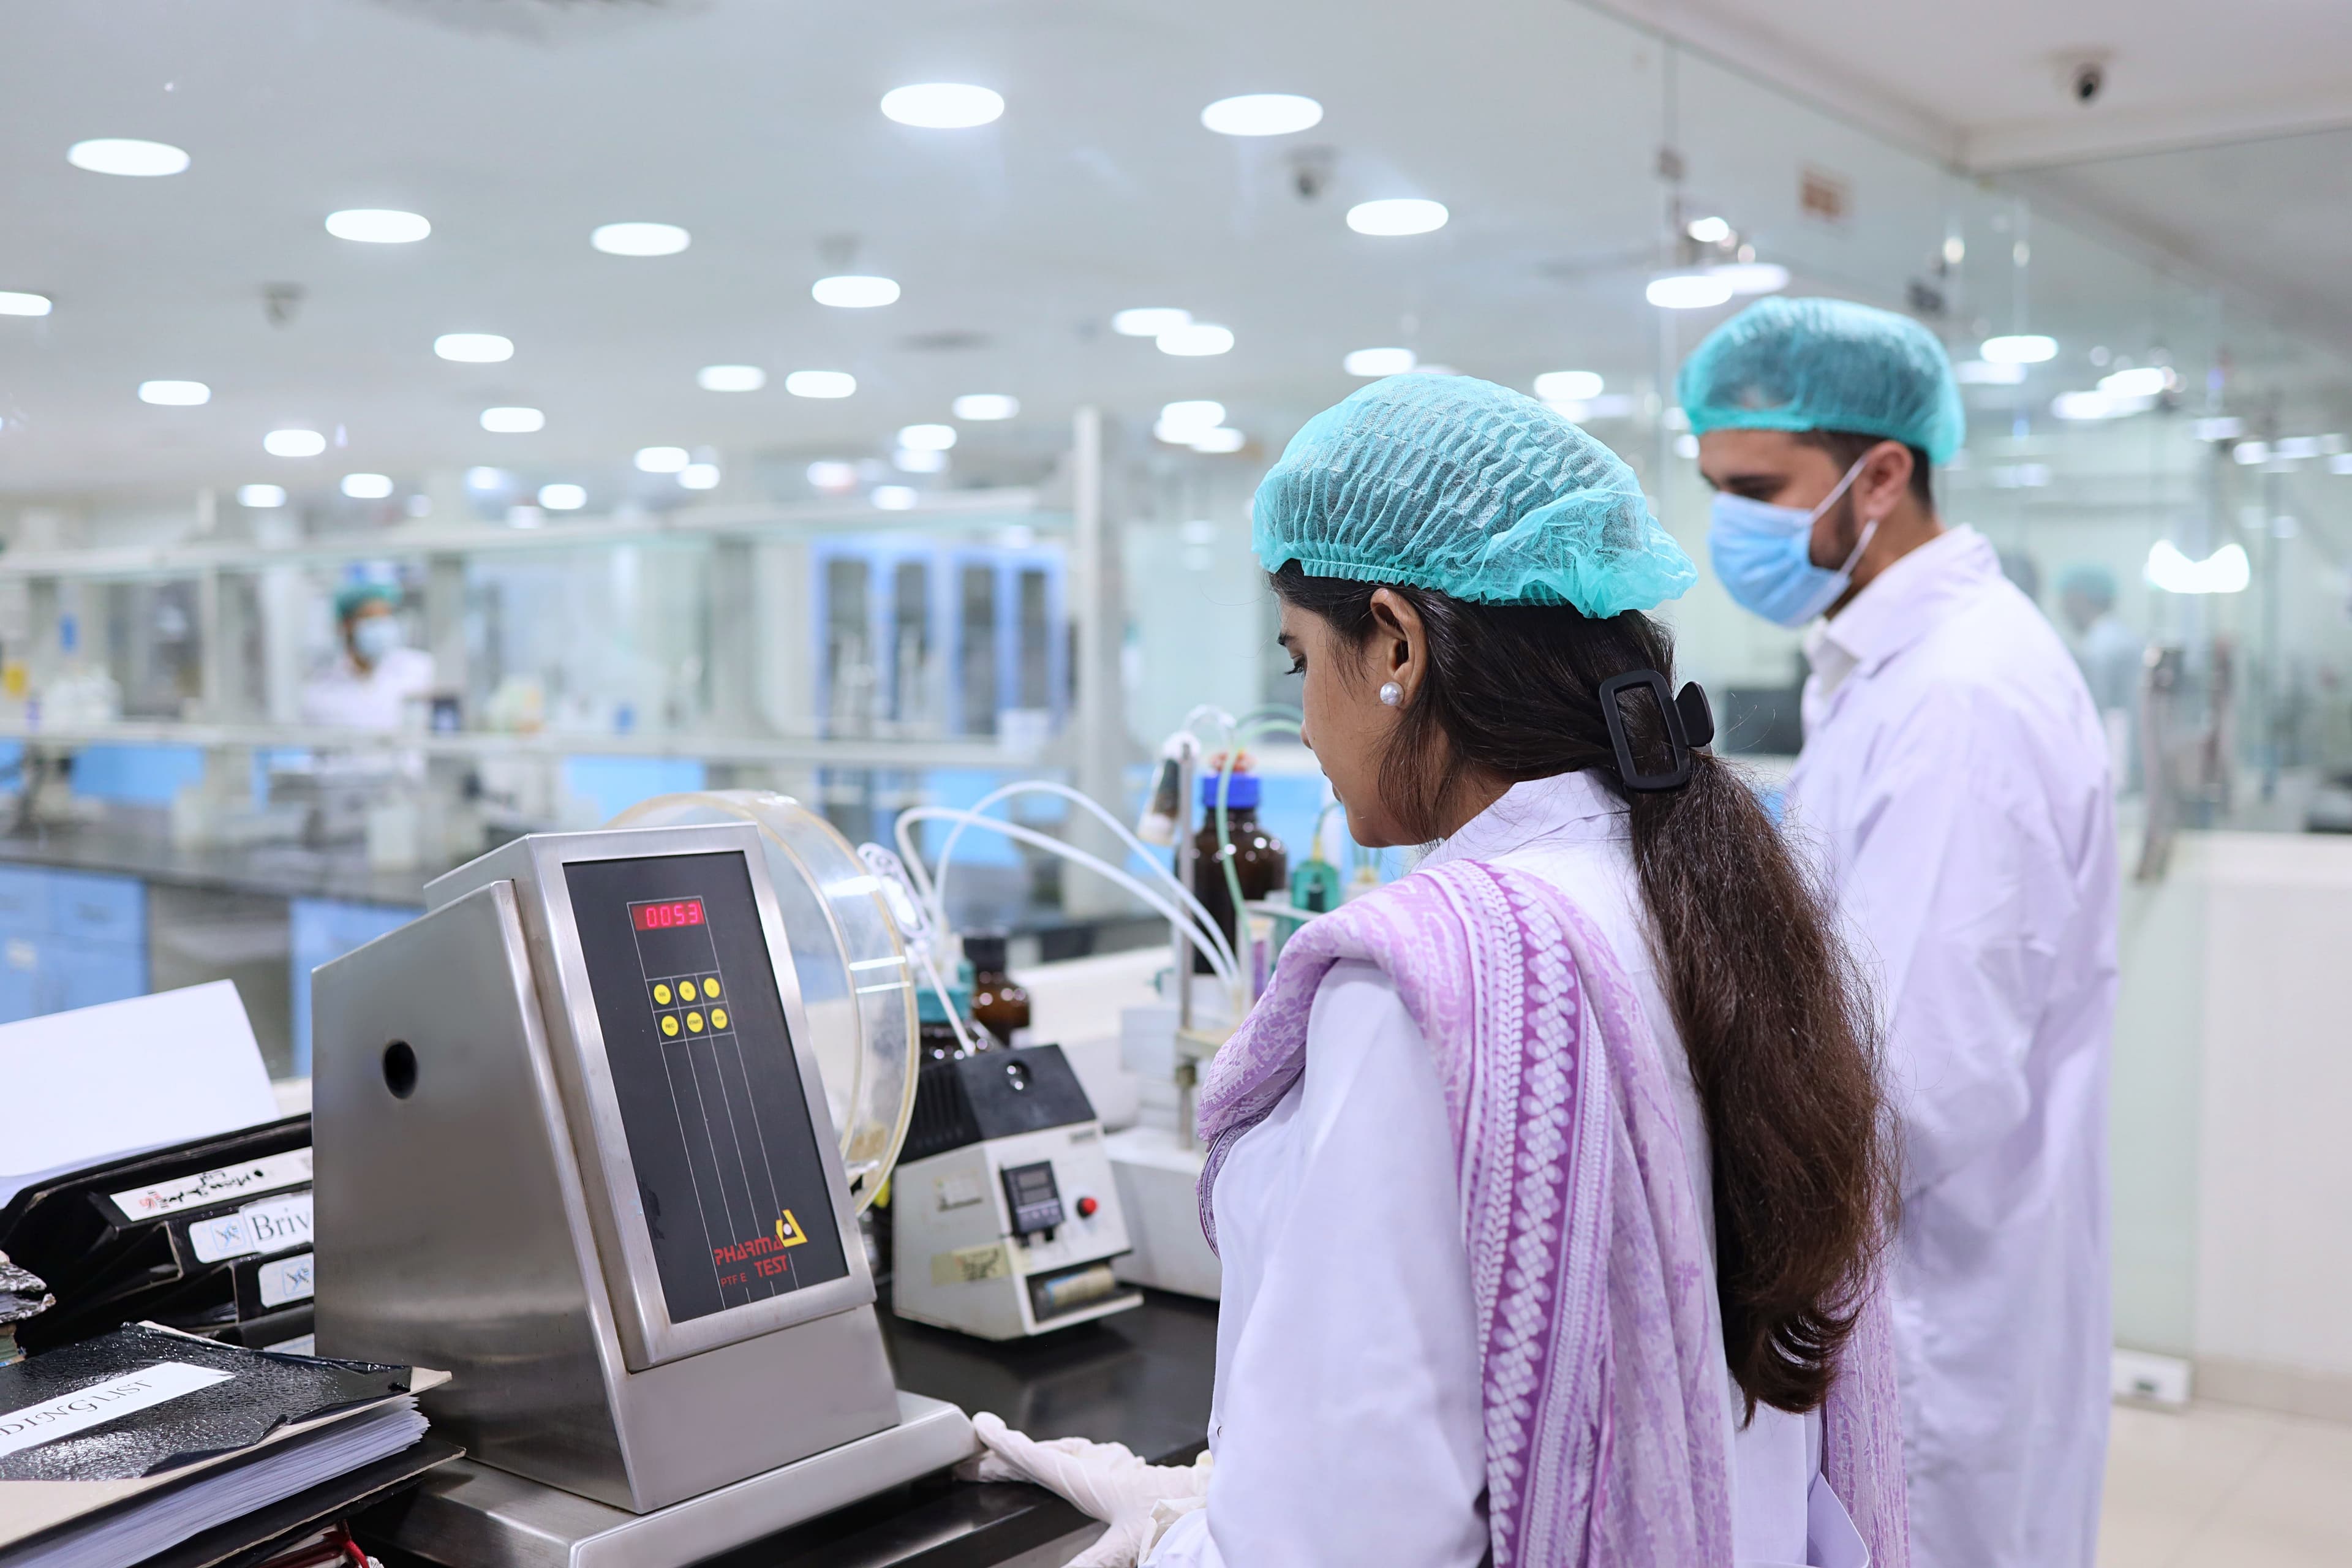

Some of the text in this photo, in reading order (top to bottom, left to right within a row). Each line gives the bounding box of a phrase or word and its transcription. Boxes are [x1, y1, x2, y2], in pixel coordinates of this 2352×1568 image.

[646, 903, 698, 927] 0053
[714, 1234, 785, 1266] PHARMA
[754, 1254, 788, 1278] TEST
[720, 1272, 748, 1287] PTF E
[0, 1380, 152, 1436] DING LIST
